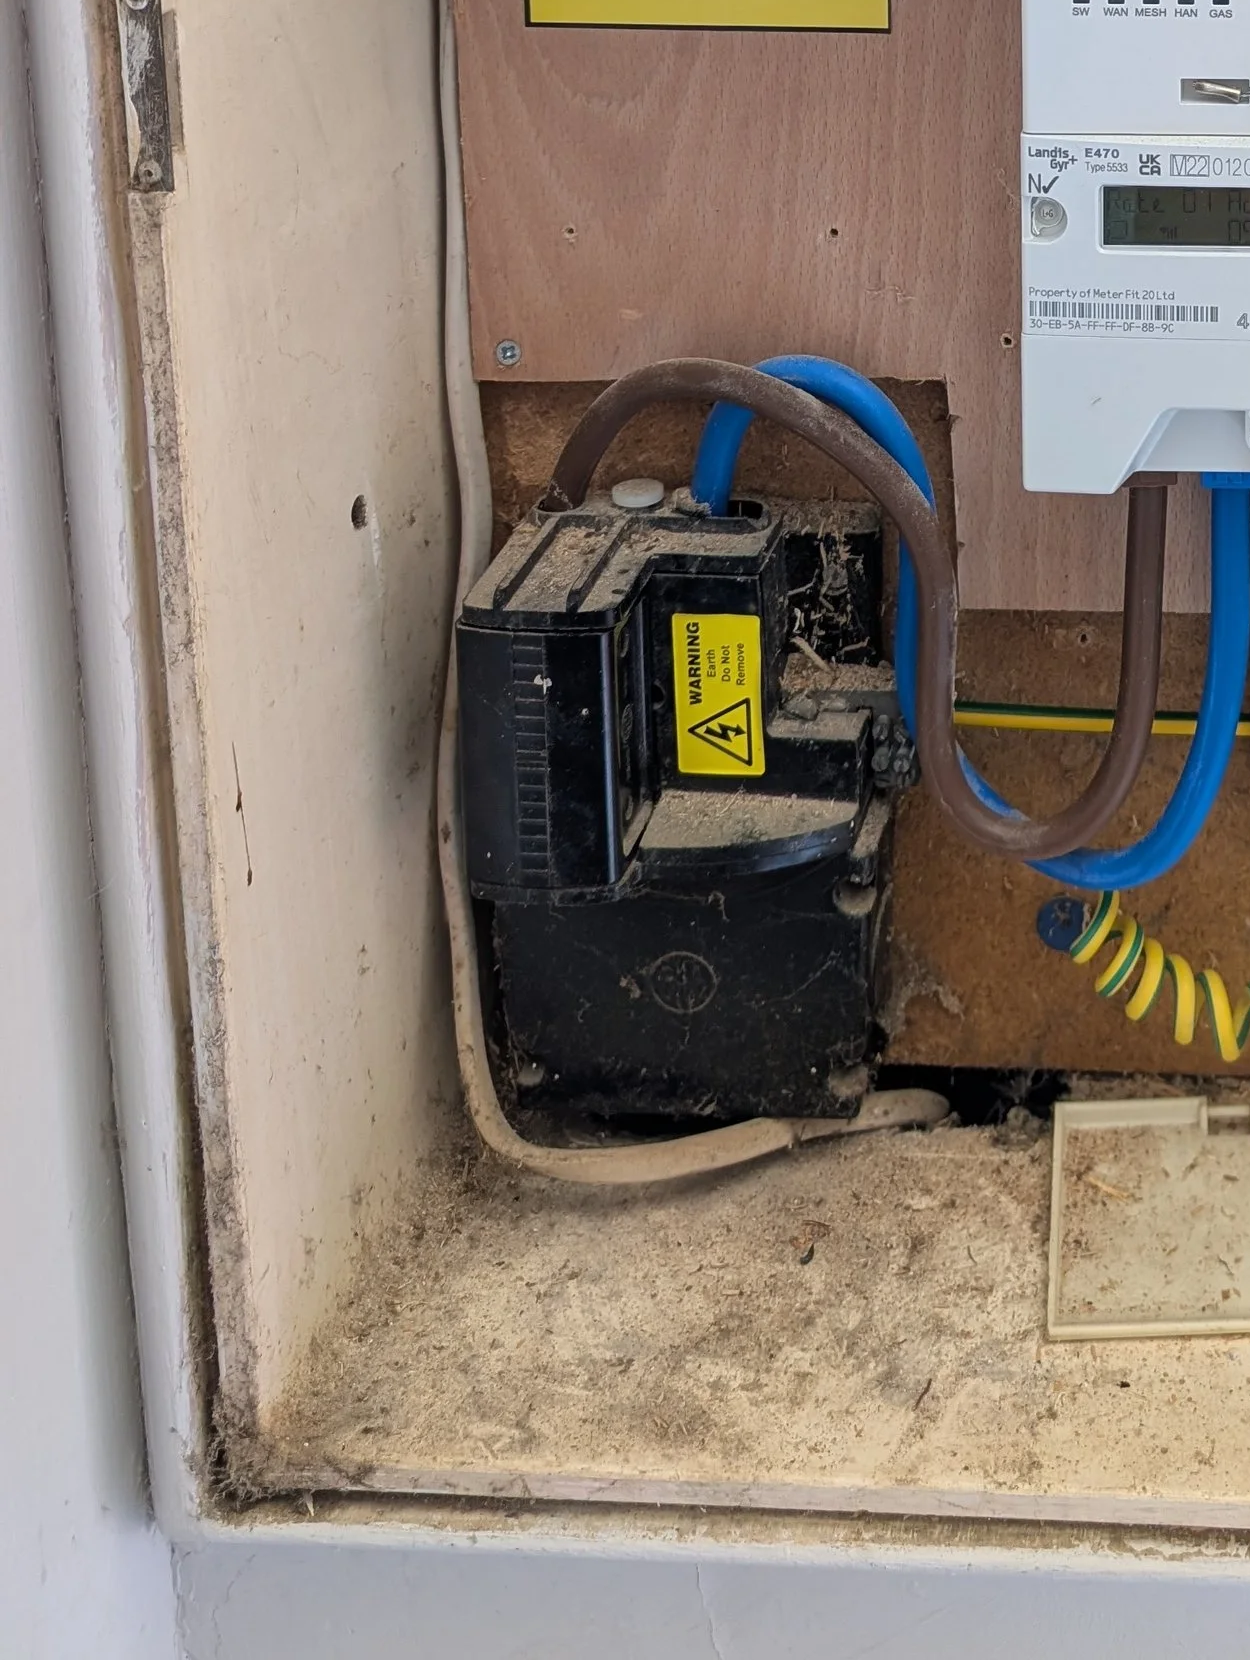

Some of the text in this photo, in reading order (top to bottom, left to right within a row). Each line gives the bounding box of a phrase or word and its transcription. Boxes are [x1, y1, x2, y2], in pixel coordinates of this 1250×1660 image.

[1072, 7, 1233, 19] SW WAN MESH HAN GAS
[1028, 146, 1070, 158] Landis
[1084, 148, 1120, 159] E470
[1084, 162, 1128, 173] Type 5533
[1028, 287, 1175, 301] Property of Meter Fit 20 Ltd
[686, 621, 702, 705] WARNING
[706, 649, 716, 678] Earth
[721, 645, 731, 682] Do Not
[736, 642, 745, 686] Remove
